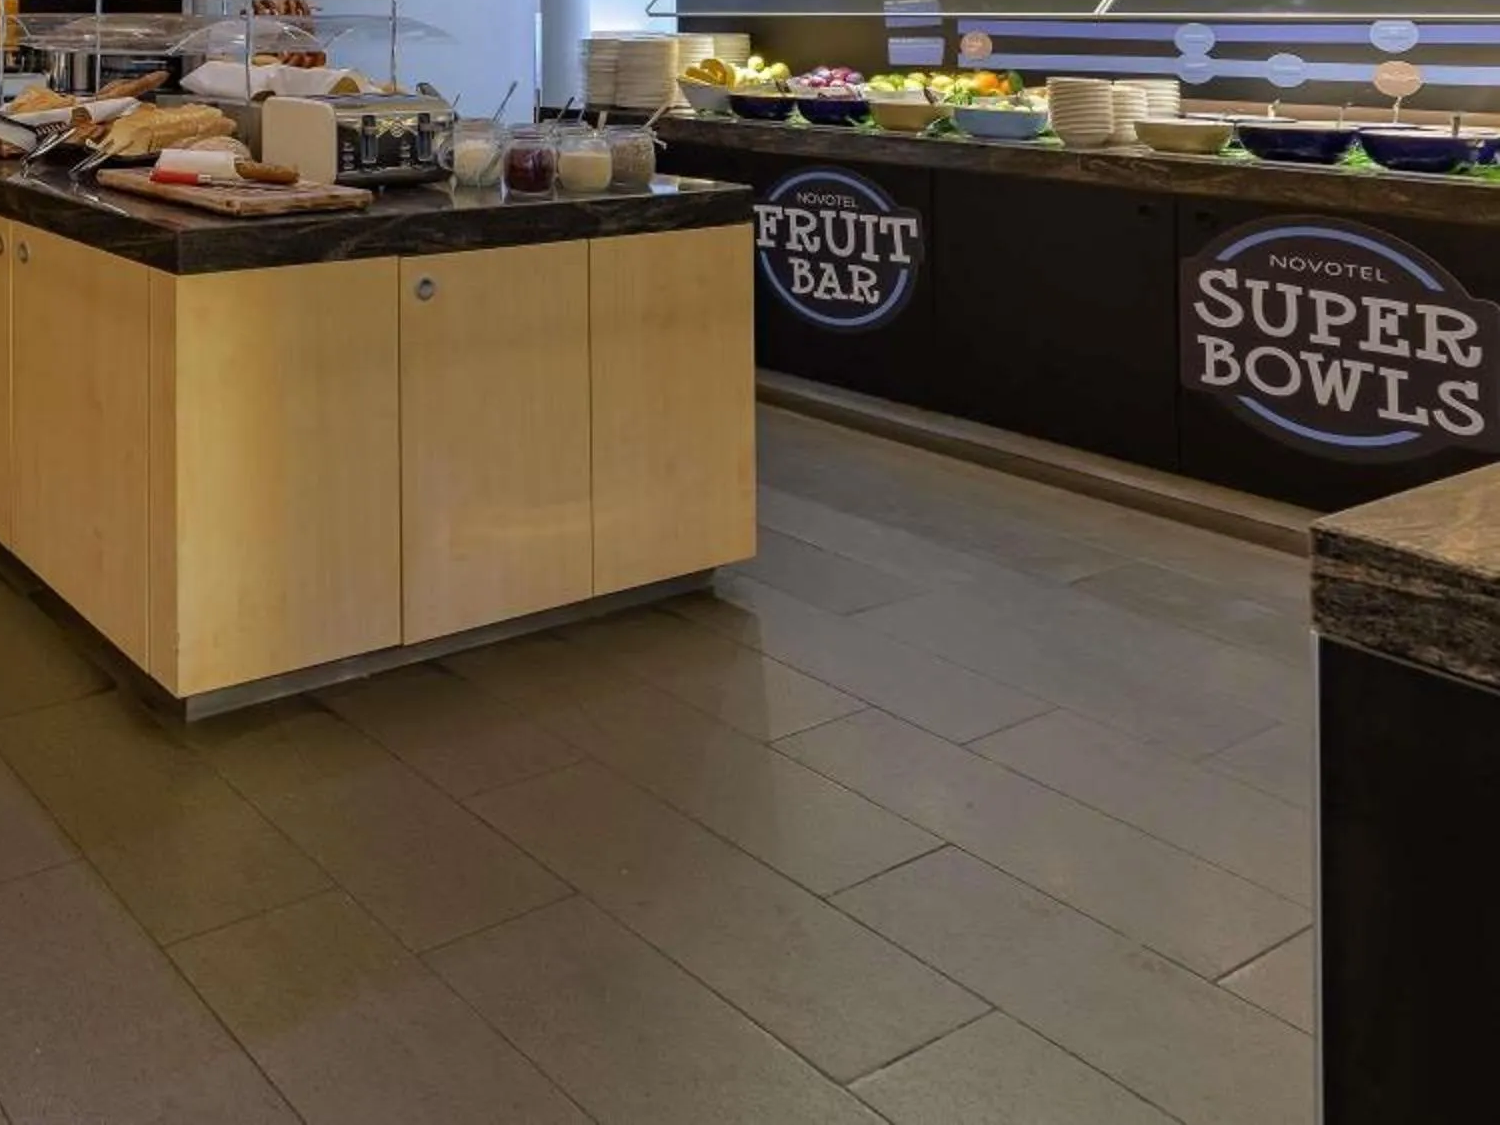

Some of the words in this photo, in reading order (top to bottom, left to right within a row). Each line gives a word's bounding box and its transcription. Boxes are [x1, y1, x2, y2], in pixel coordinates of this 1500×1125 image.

[796, 192, 858, 208] NOVOTEL
[753, 204, 918, 263] FRUIT
[788, 256, 880, 304] BAR
[1268, 253, 1390, 284] NOVOTEL
[1193, 268, 1483, 368] SUPER
[1197, 334, 1485, 436] BOWLS
